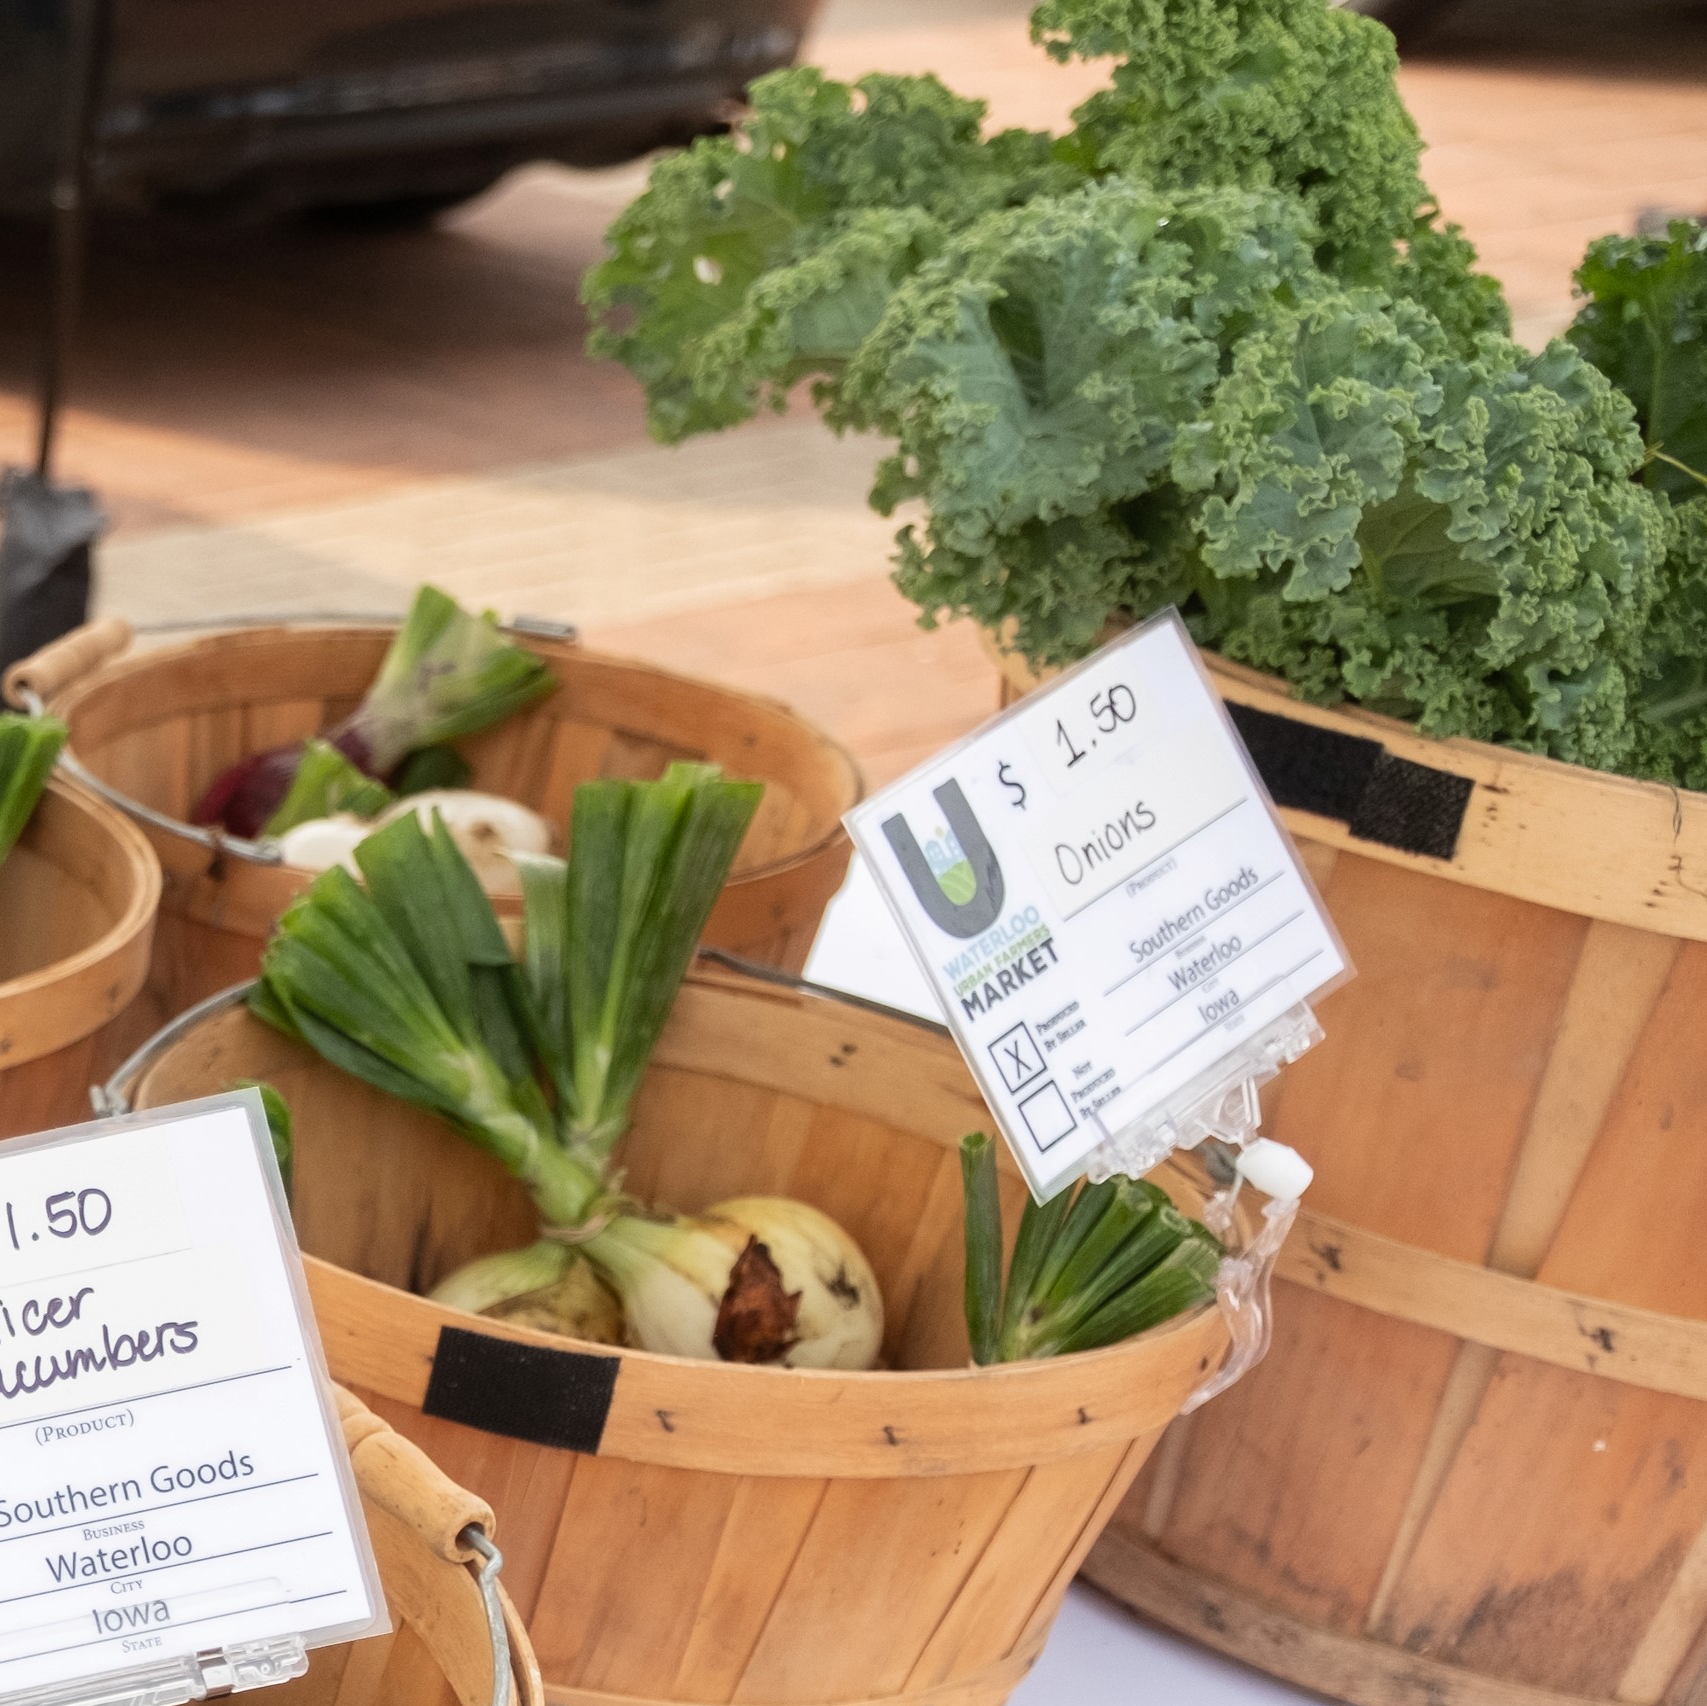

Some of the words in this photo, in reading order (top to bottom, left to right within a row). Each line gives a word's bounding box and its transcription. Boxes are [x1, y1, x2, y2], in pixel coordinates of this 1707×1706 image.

[998, 761, 1027, 811] $
[1057, 684, 1136, 768] 1.50
[1054, 801, 1157, 885] Onions
[942, 905, 1041, 980] WATERLOO
[1128, 904, 1206, 964] Southern
[1204, 867, 1259, 911] Goods
[994, 923, 1051, 970] FARMERS
[1167, 936, 1242, 992] Waterloo
[960, 937, 1060, 1022] MARKET
[1198, 988, 1240, 1024] Iowa
[5, 1188, 112, 1250] 1.50
[150, 1450, 255, 1493] Goods
[45, 1536, 193, 1583] Waterloo
[92, 1599, 172, 1635] Iowa
